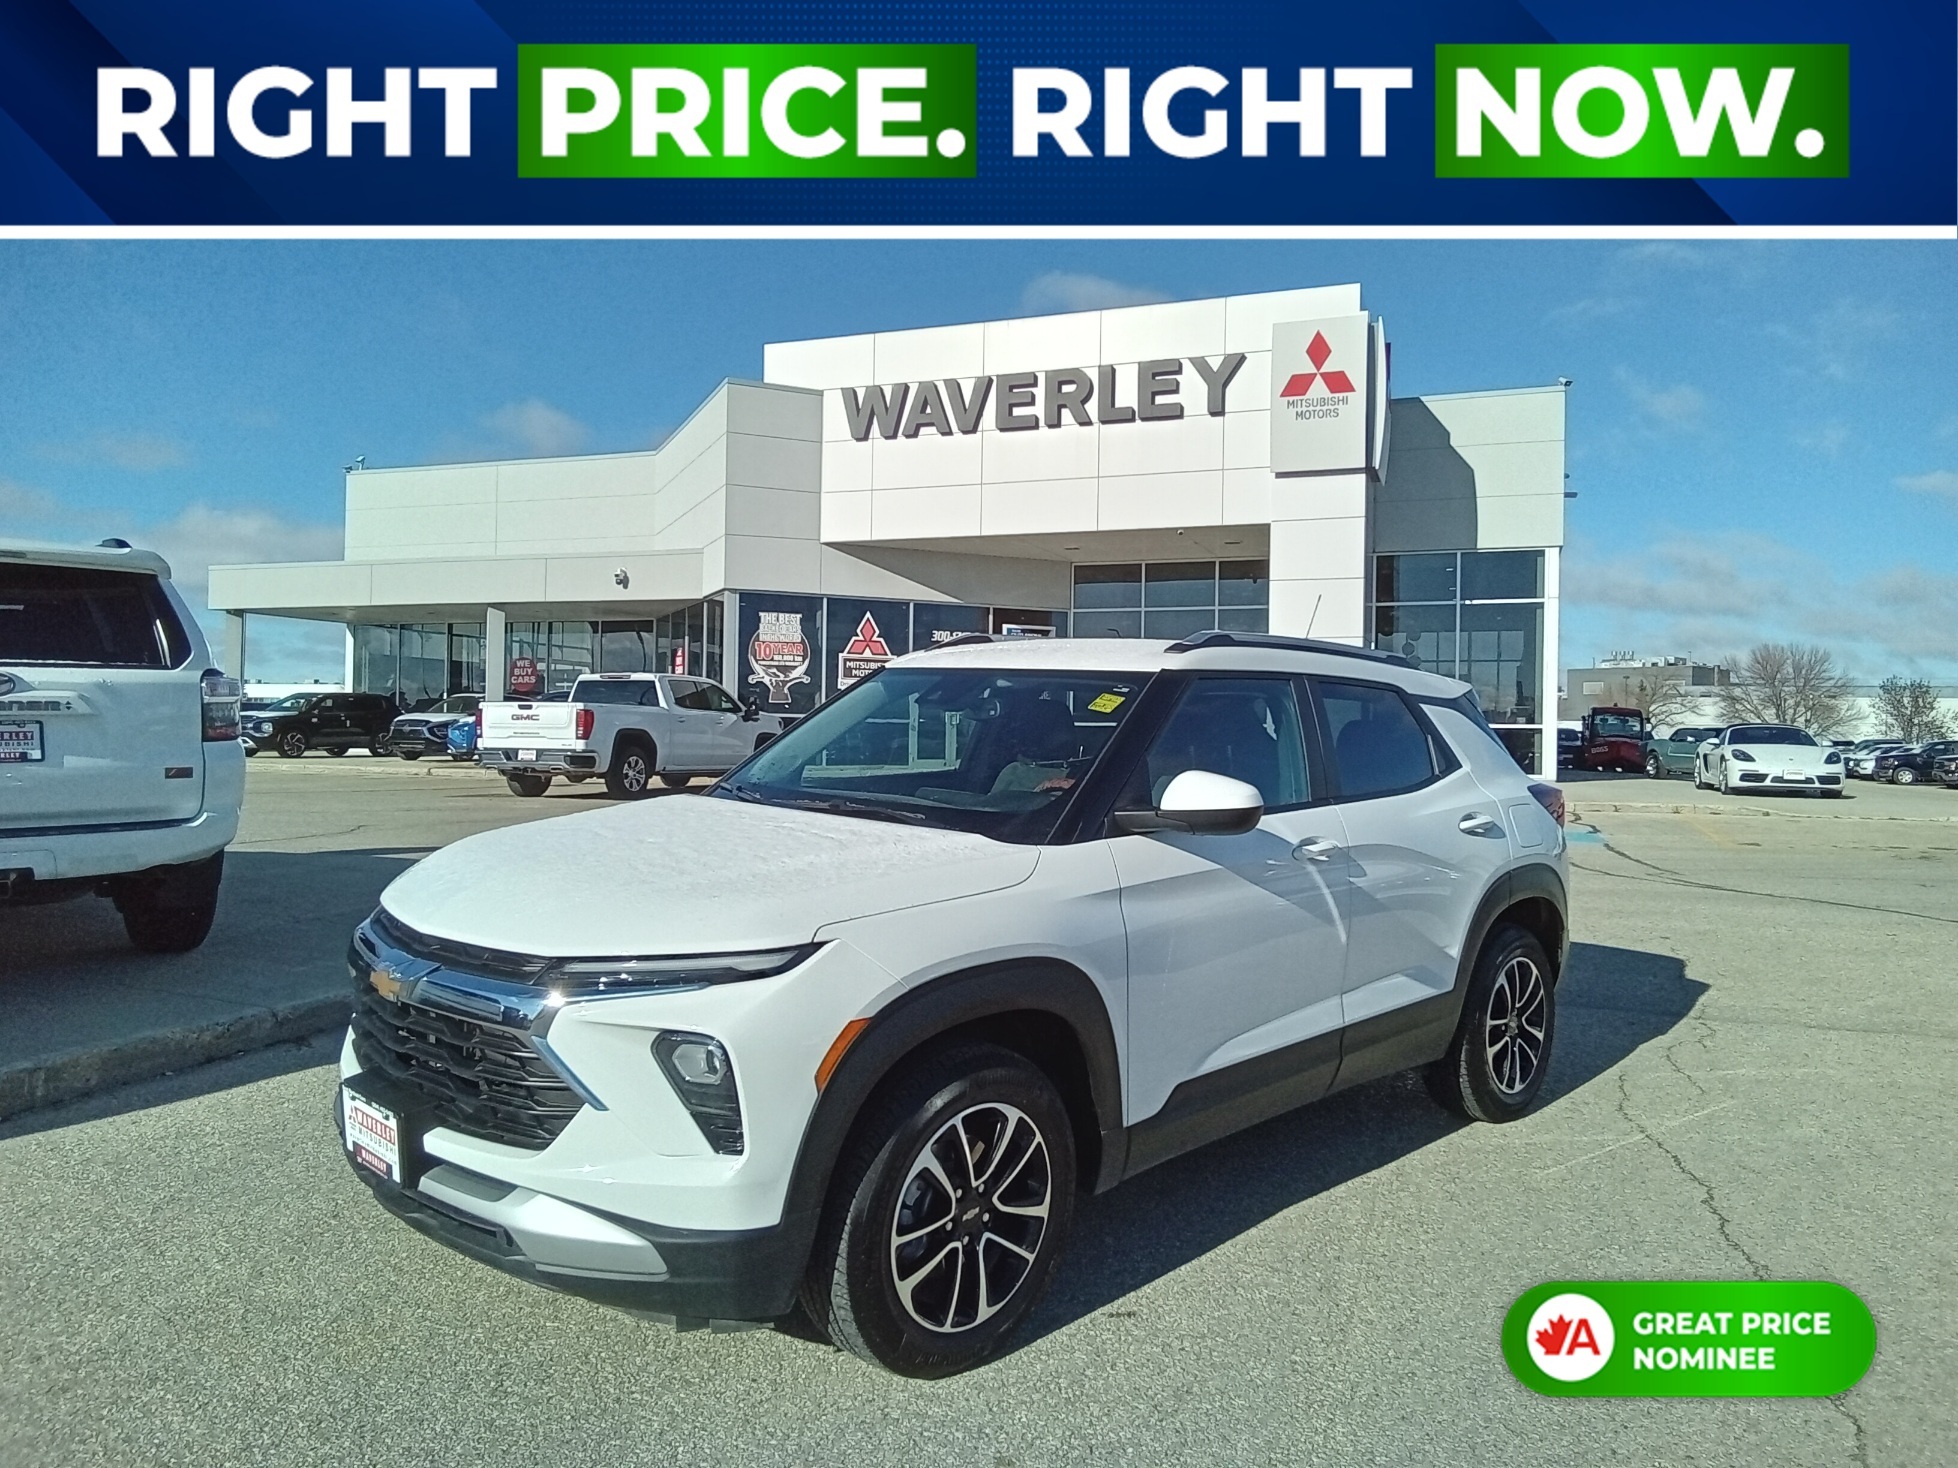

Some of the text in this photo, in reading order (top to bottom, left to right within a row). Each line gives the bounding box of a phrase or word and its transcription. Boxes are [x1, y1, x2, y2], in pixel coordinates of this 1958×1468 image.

[840, 353, 1247, 441] WAVERLEY
[1287, 396, 1349, 409] MITSUBISHI
[1295, 408, 1340, 421] MOTORS
[759, 612, 802, 626] THE BEST
[755, 642, 804, 660] 10 YEAR
[514, 668, 533, 676] BUY
[511, 676, 536, 684] CARS
[0, 732, 33, 740] RLEY
[356, 1108, 395, 1145] WAVERLEY
[358, 1126, 397, 1157] MITSUBISHI
[361, 1148, 387, 1173] WAVERLEY
